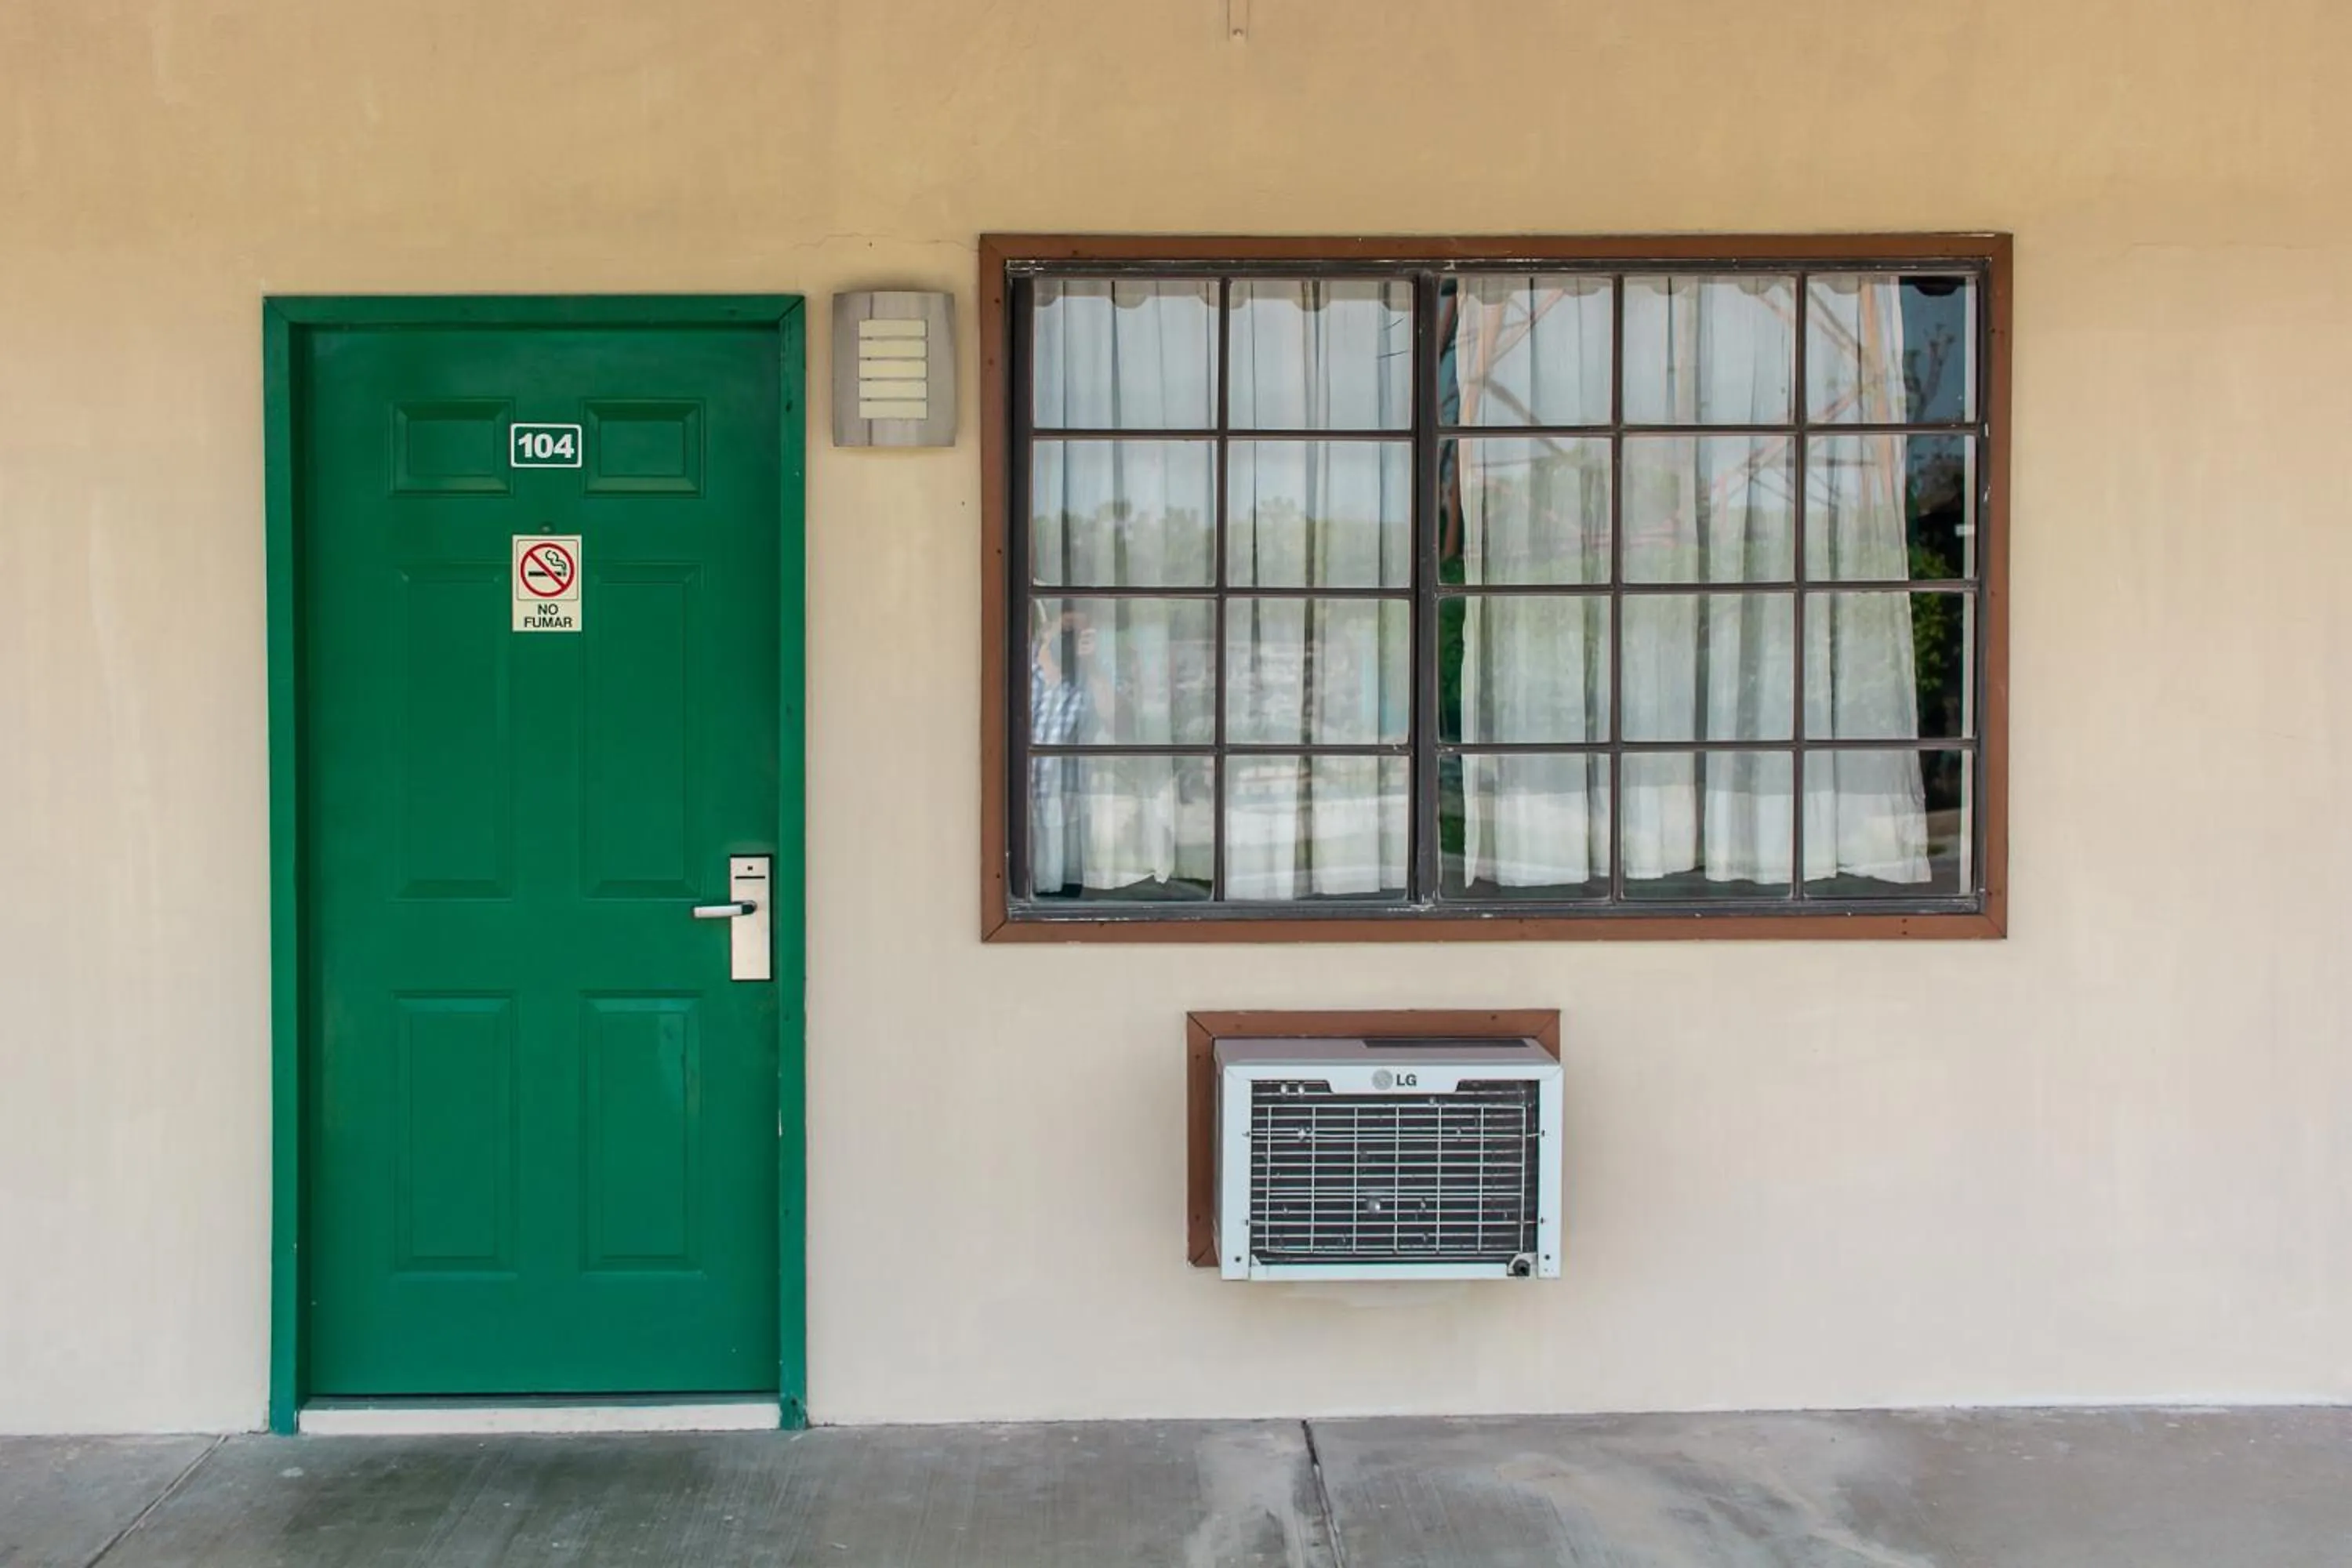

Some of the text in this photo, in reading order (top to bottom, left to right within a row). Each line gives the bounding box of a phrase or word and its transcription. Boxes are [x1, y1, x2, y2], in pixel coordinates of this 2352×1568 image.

[517, 433, 575, 459] 104
[537, 604, 559, 615] NO
[524, 617, 573, 628] FUMAR
[1396, 1074, 1417, 1087] LG
